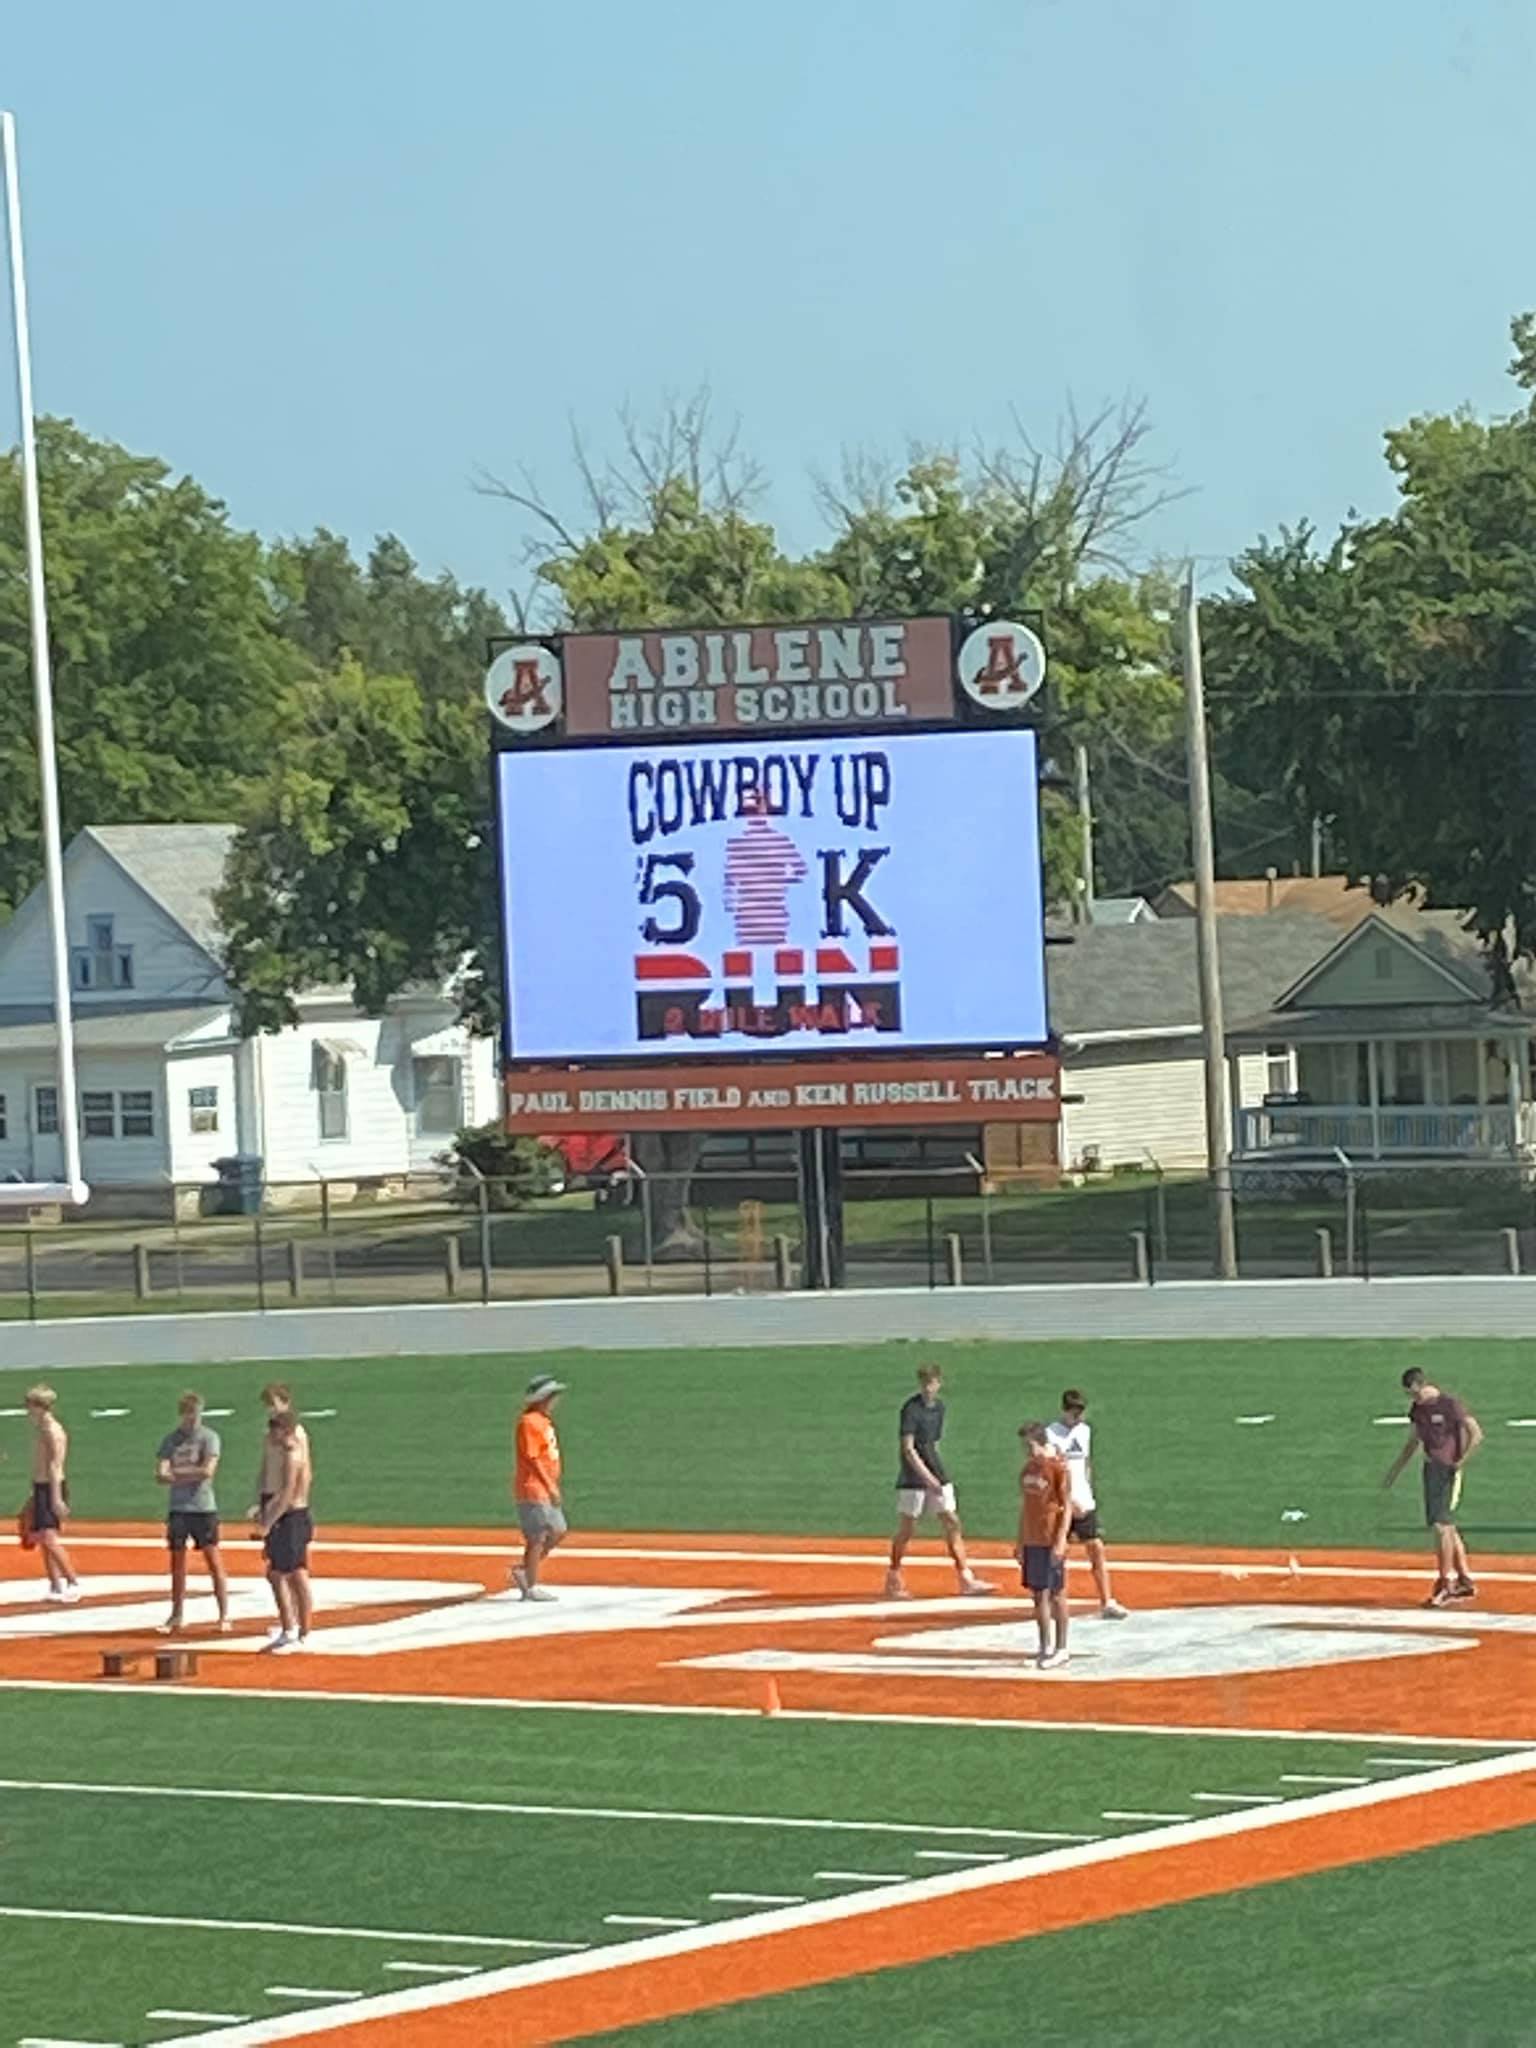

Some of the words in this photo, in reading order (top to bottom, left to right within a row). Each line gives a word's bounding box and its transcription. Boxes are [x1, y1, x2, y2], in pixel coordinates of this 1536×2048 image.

[609, 625, 906, 690] ABILENE
[610, 690, 717, 729] HIGH
[734, 681, 907, 723] SCHOOL
[628, 753, 820, 845] COWBOY
[831, 751, 892, 831] UP
[636, 851, 702, 945] 5
[816, 846, 898, 939] K
[510, 1090, 575, 1115] PAUL
[578, 1088, 669, 1112] DENNIS
[673, 1086, 742, 1110] FIELD
[747, 1089, 791, 1108] AND
[794, 1082, 848, 1106] KEN
[852, 1079, 961, 1104] RUSSELL
[966, 1077, 1056, 1103] TRACK
